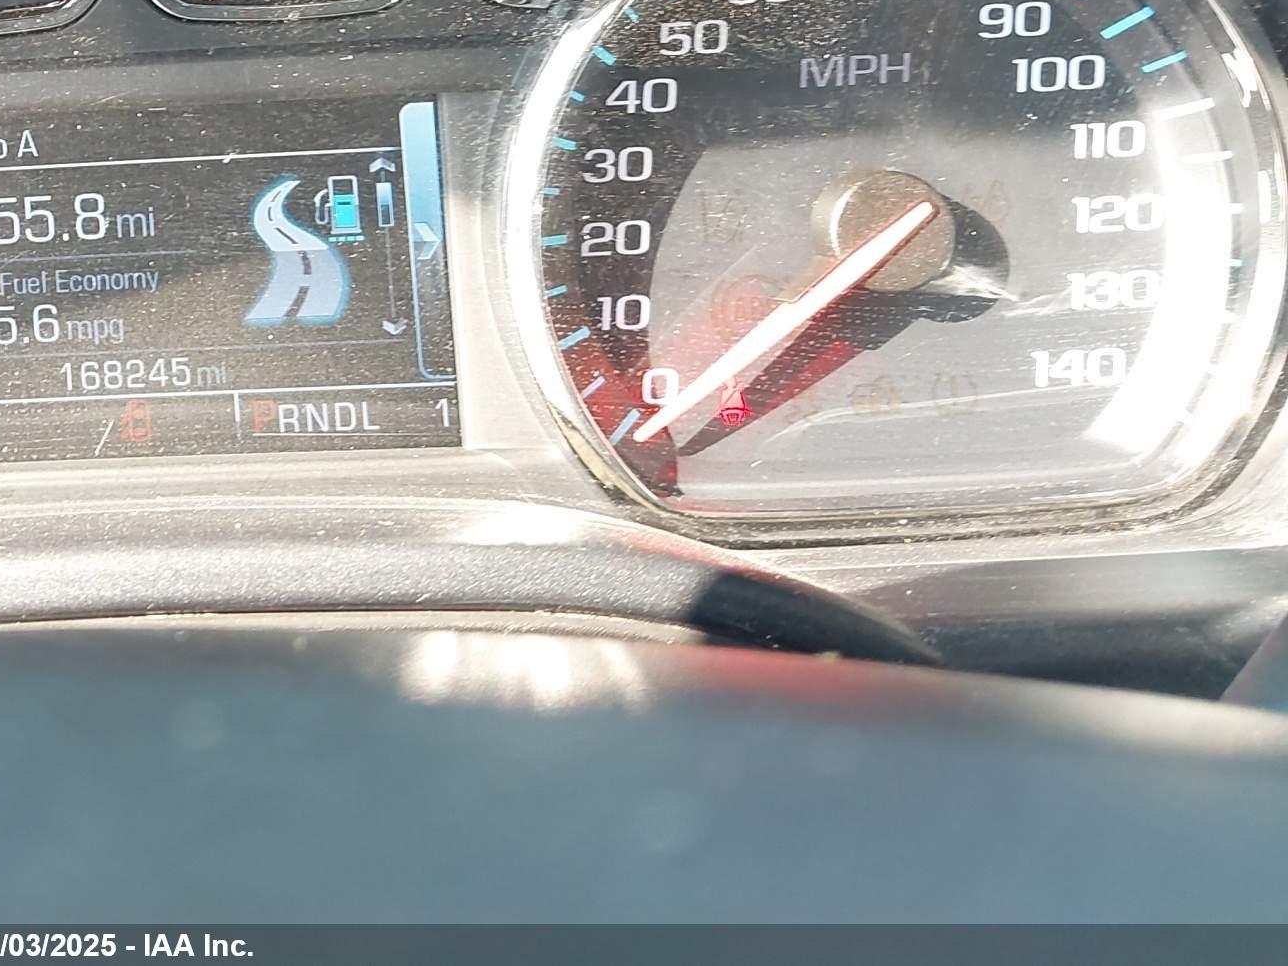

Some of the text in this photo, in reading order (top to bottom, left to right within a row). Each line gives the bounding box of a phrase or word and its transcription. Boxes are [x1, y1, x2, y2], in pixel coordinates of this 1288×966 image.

[658, 19, 730, 56] 50
[977, 1, 1052, 39] 90
[799, 52, 912, 89] MPH
[1011, 54, 1106, 93] 100
[604, 78, 678, 114] 40
[17, 129, 40, 158] A
[1068, 120, 1147, 159] 110
[582, 146, 654, 183] 30
[116, 206, 156, 238] mi
[1071, 195, 1163, 234] 120
[580, 220, 651, 257] 20
[54, 268, 160, 294] Economy
[66, 316, 125, 345] mpg
[596, 294, 651, 331] 10
[60, 356, 192, 391] 168245
[641, 367, 680, 407] 0
[1029, 348, 1128, 389] 140
[434, 397, 450, 428] 1
